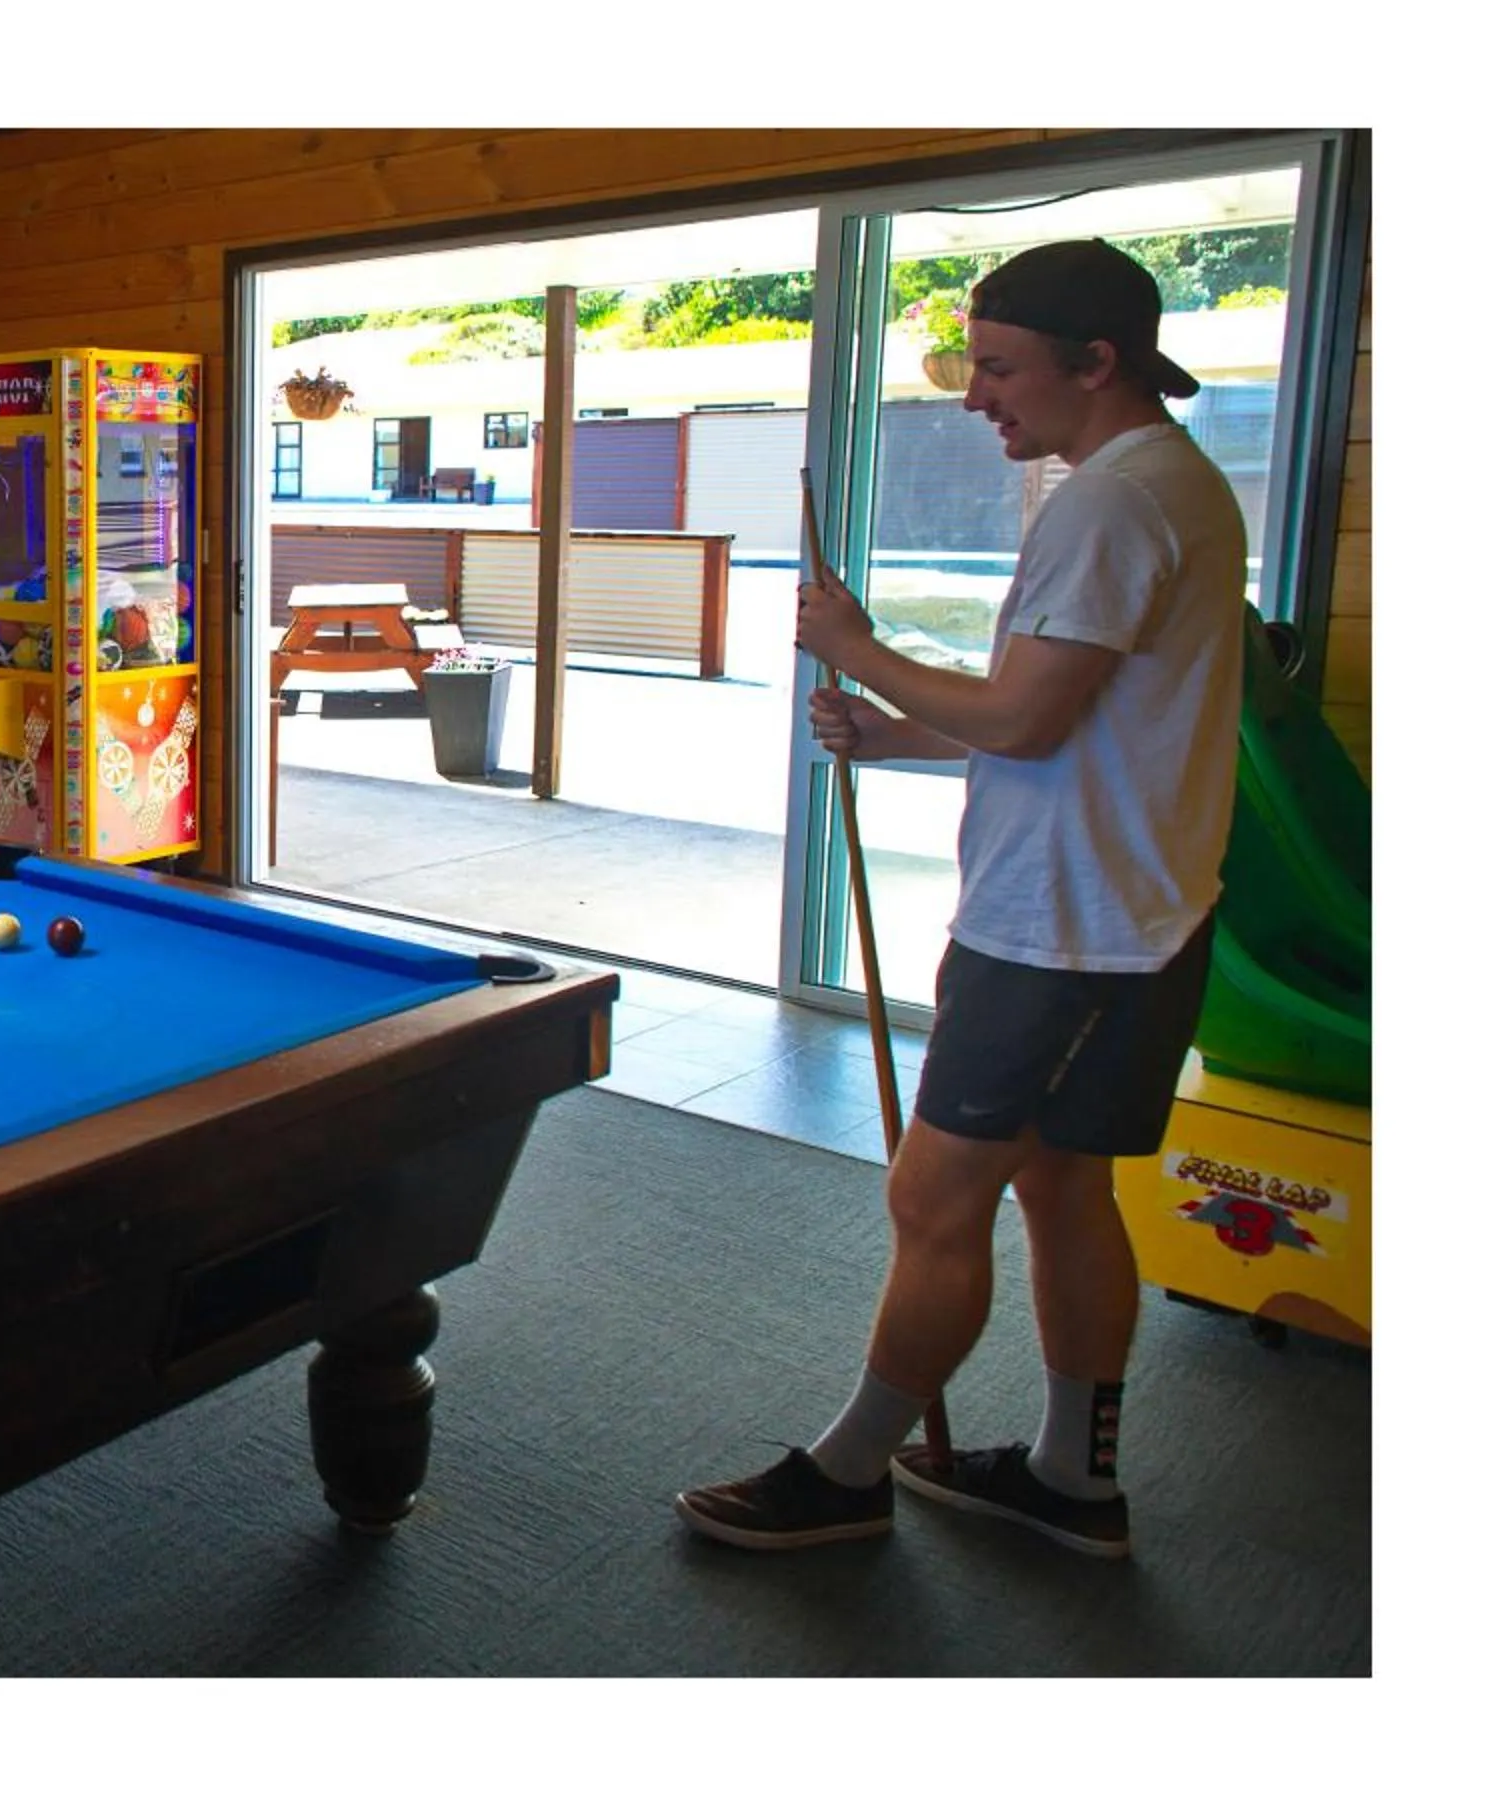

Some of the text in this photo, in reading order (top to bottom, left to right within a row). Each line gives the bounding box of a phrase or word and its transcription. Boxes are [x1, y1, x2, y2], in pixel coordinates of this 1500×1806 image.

[1176, 1156, 1332, 1214] FINAL LAP
[1215, 1199, 1277, 1257] 3
